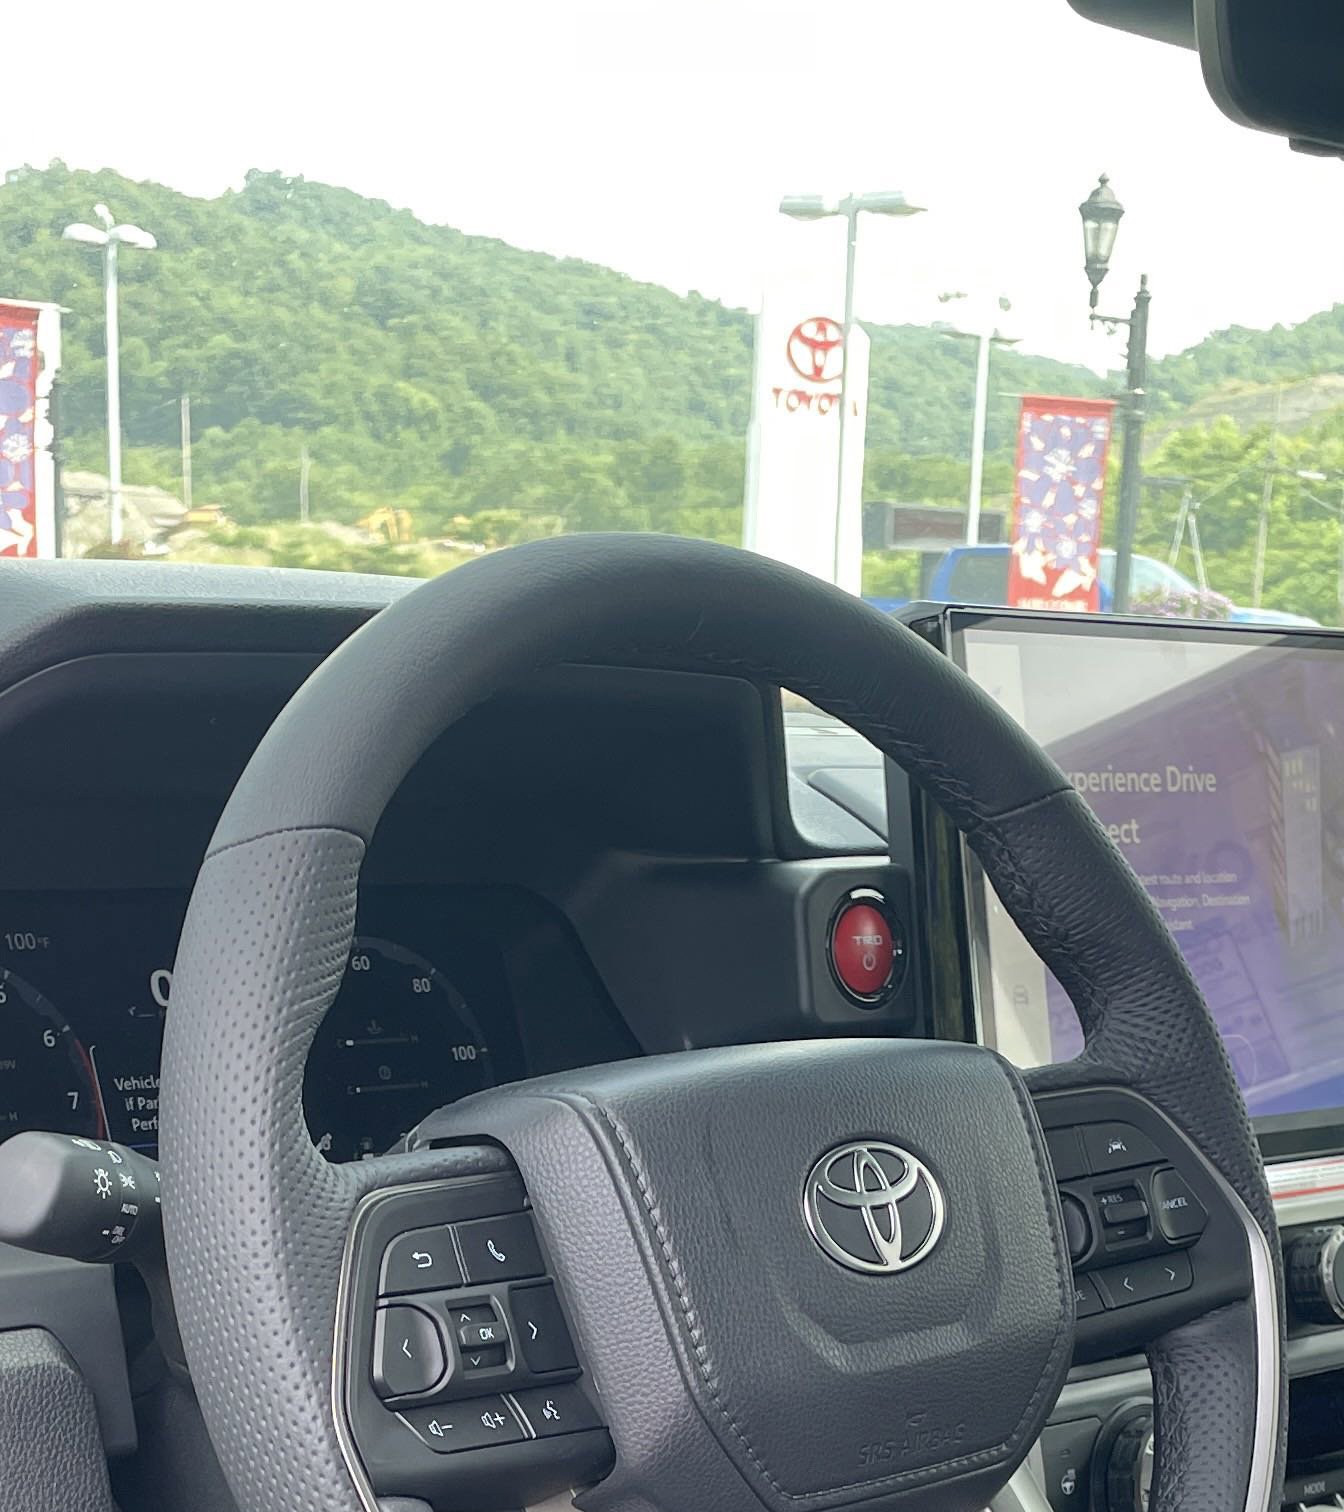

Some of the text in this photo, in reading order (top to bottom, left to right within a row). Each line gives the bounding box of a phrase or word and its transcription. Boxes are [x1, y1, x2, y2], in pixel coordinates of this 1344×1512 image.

[1067, 764, 1217, 793] perience Drive
[351, 955, 370, 971] 60
[412, 977, 432, 993] 80
[43, 1029, 56, 1048] 6
[451, 1044, 477, 1061] 100
[67, 1091, 80, 1111] 7
[137, 1096, 159, 1111] Par
[131, 1115, 159, 1132] Perf
[1159, 1196, 1189, 1210] ANCEL
[479, 1327, 495, 1340] OK
[1303, 1481, 1326, 1497] MODE
